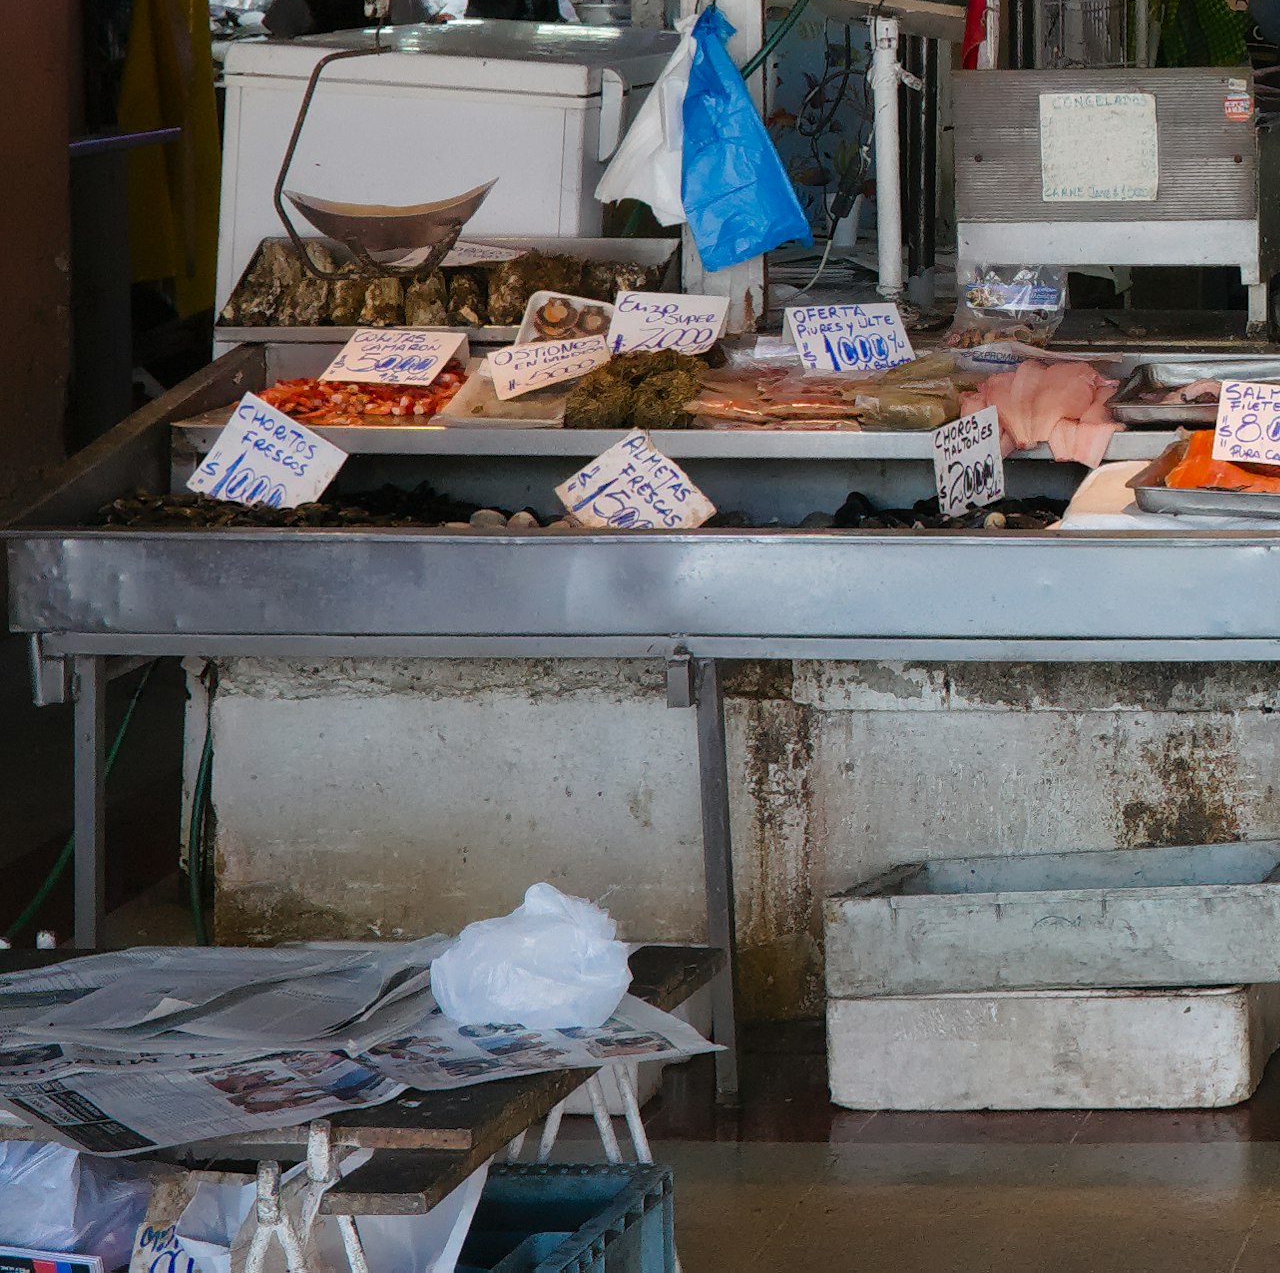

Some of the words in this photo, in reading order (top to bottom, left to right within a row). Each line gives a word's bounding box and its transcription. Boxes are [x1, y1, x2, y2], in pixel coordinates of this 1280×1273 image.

[793, 305, 866, 324] OFERTA
[858, 315, 895, 328] ULTE
[361, 343, 443, 352] CAMARON
[935, 415, 979, 449] CHOROS
[943, 423, 993, 461] MALTONES
[241, 430, 308, 477] FRESCOS
[618, 462, 682, 527] FRESCAS
